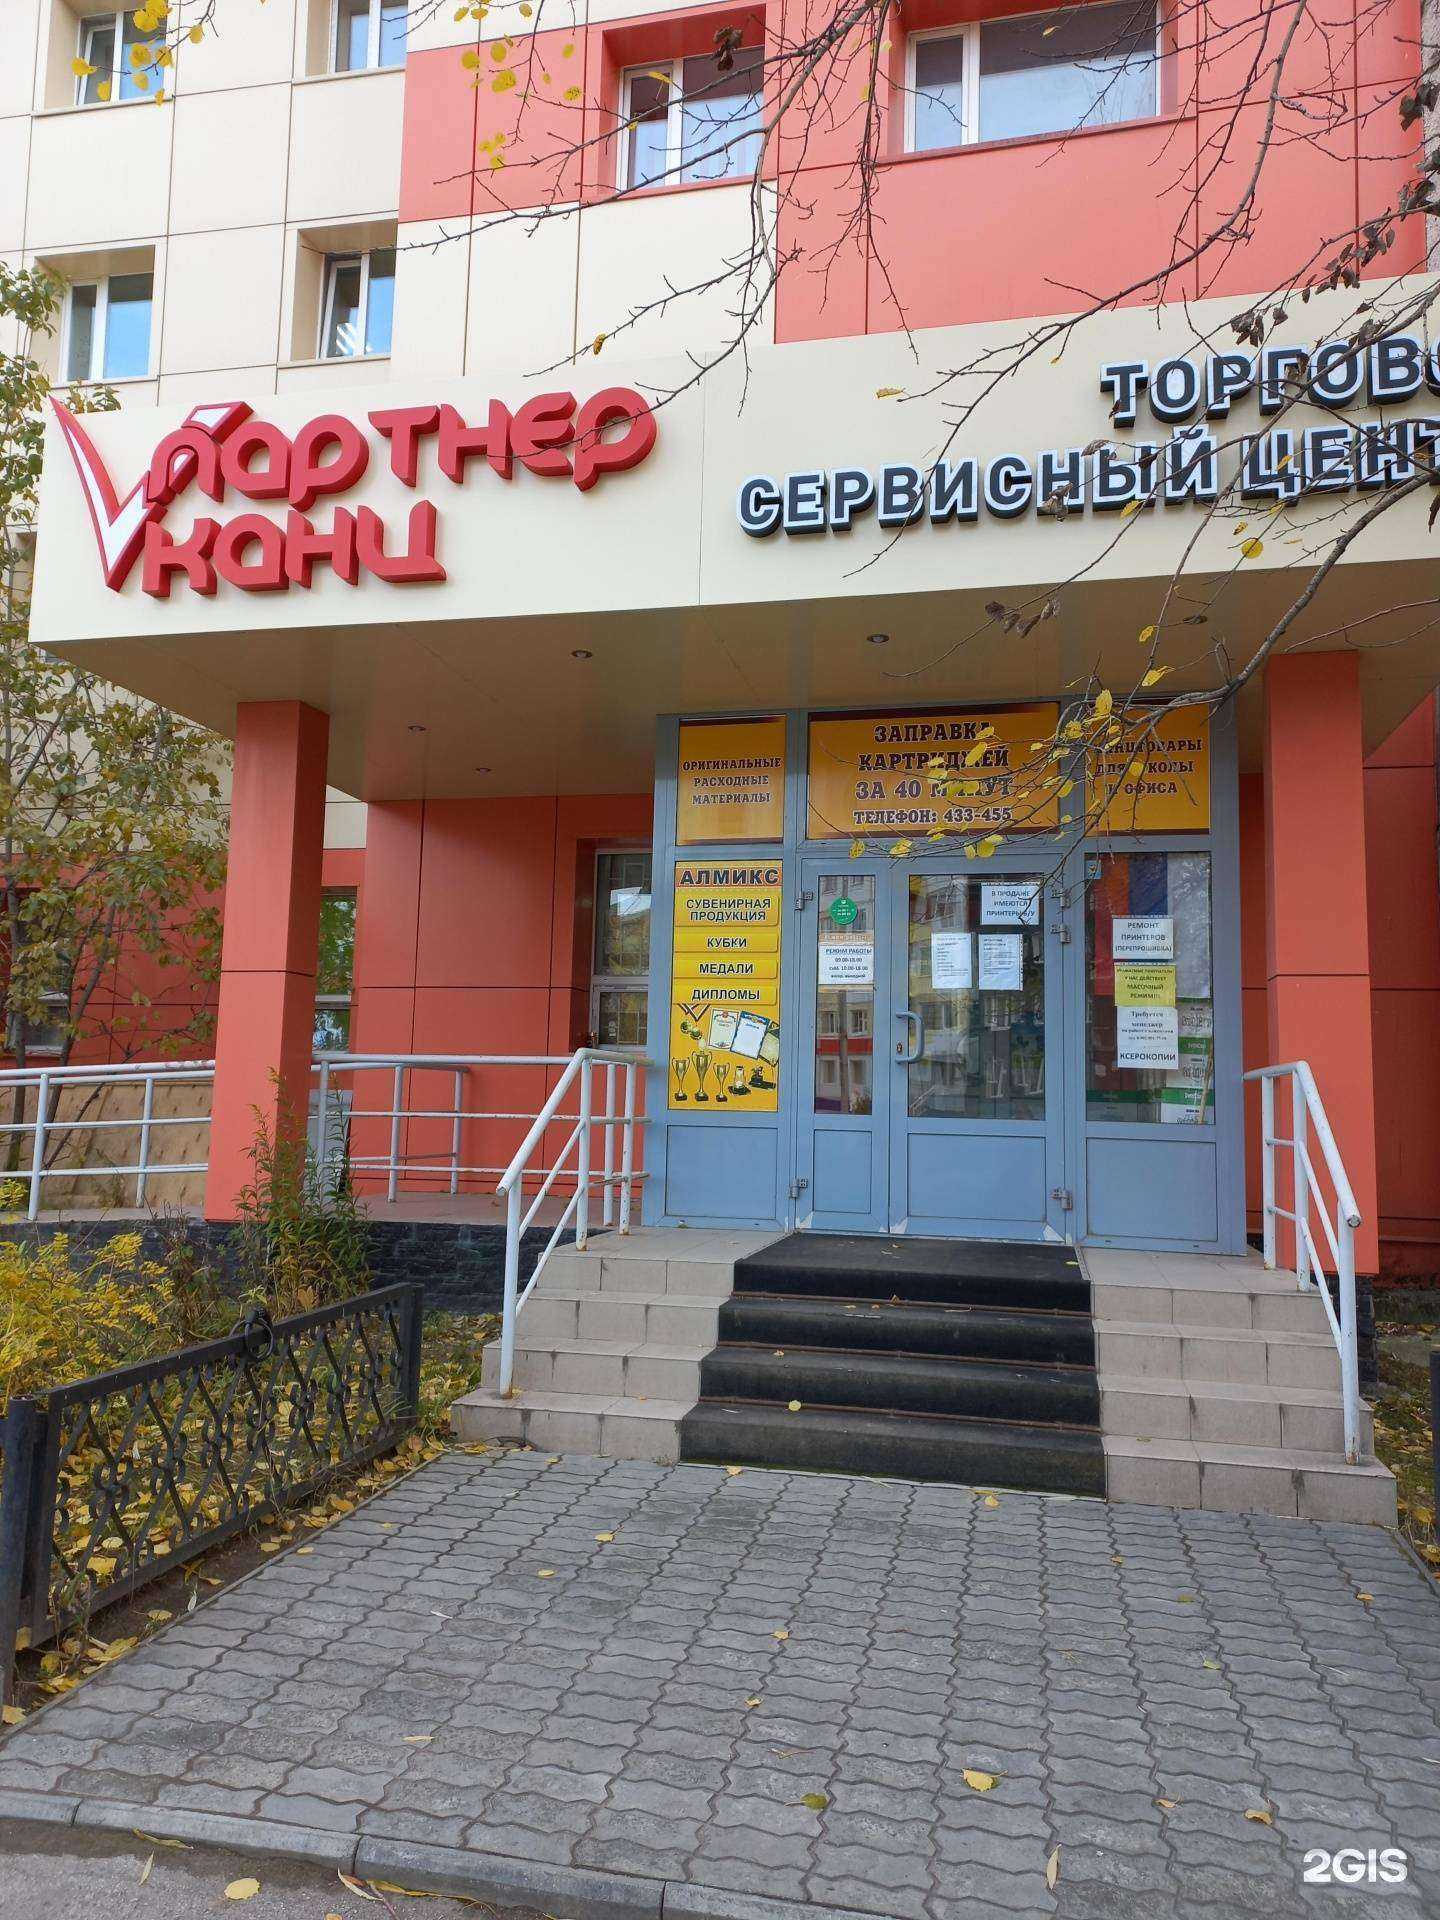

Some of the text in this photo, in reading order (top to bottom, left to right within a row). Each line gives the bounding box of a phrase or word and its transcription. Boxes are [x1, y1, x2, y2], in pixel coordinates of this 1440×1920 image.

[736, 424, 1218, 538] СЕРВИСНЫЙ
[682, 757, 782, 772] ОРИГИНАЛЬНЫЕ
[1132, 760, 1194, 774] КОЛЫ
[693, 775, 769, 788] РАСХОДНЫЕ
[855, 781, 886, 800] ЗА
[894, 780, 922, 799] 40
[1124, 782, 1178, 796] ОФИСА
[692, 792, 771, 805] МАТЕРИАЛЫ
[853, 807, 1013, 825] ТЕЛЕФОН: 433-455
[680, 868, 779, 885] АЛМИКС
[686, 898, 771, 909] СУВЕНИРНАЯ
[690, 911, 766, 922] ПРОДУКЦИЯ
[707, 938, 747, 948] КУБКИ
[699, 963, 754, 975] МЕДАЛИ
[691, 989, 760, 1000] ДИПЛОМЫ
